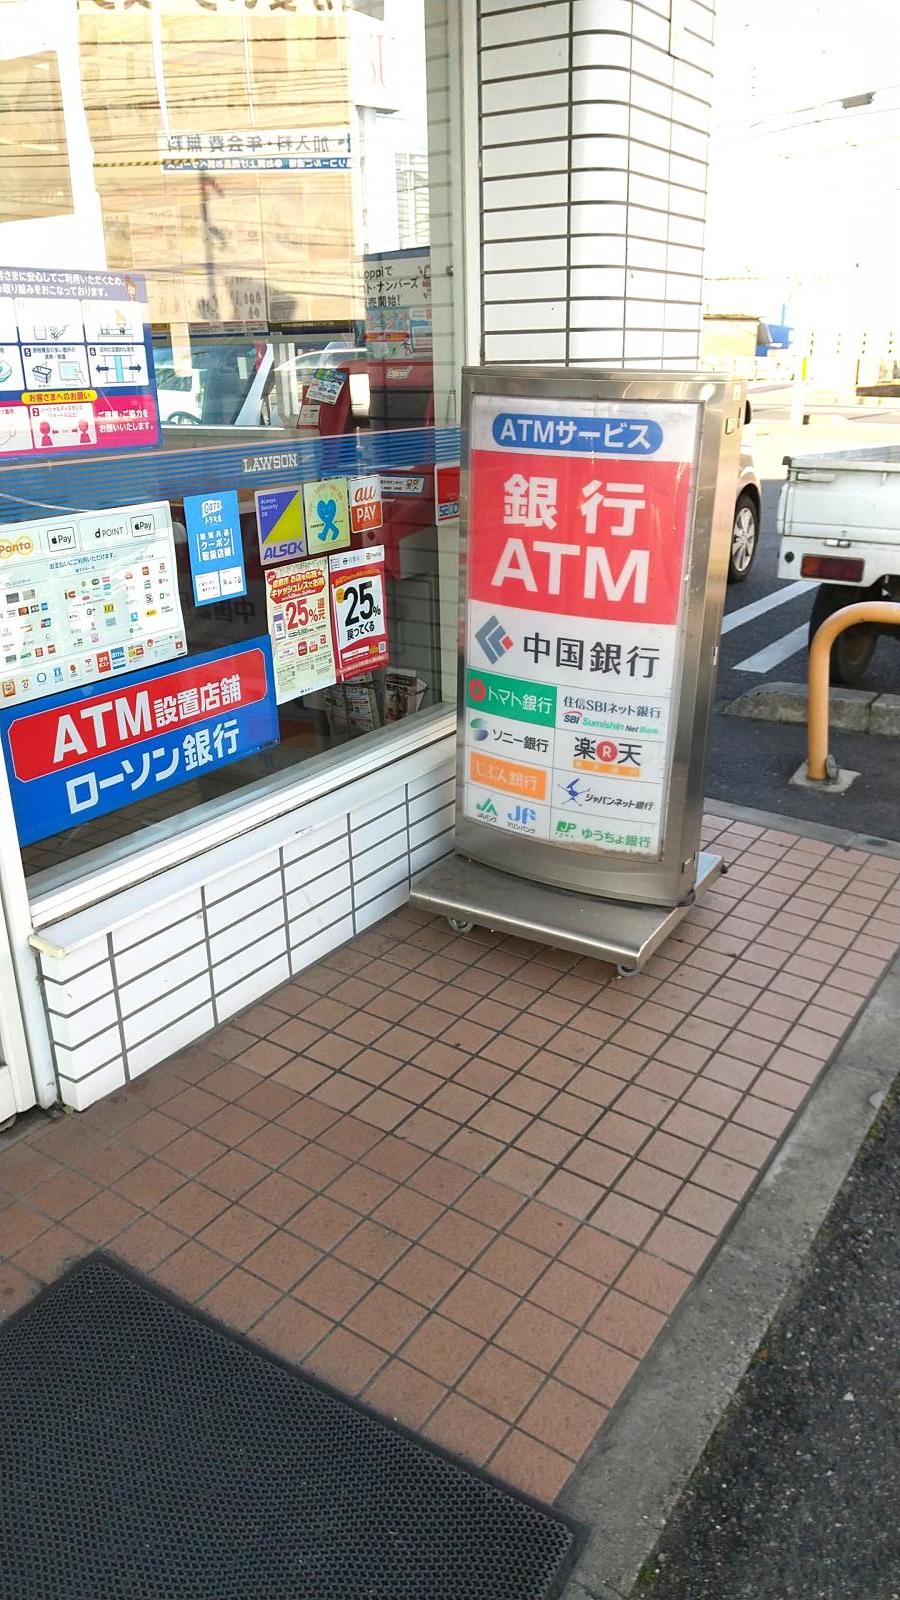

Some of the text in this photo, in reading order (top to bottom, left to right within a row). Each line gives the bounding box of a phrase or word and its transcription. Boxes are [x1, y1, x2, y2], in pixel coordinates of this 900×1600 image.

[365, 294, 401, 308] 売開始!
[29, 391, 91, 403] お客さまへのお願い
[499, 418, 652, 450] ATMサービス
[242, 453, 298, 473] LAWSON
[354, 486, 376, 502] au
[356, 505, 378, 522] PAY
[503, 474, 646, 537] 銀行
[102, 526, 124, 537] POINT
[139, 521, 152, 532] Pay
[0, 540, 31, 555] Ponta
[58, 534, 72, 545] Pay
[201, 537, 231, 551] クーポン
[263, 541, 304, 561] ALSOK
[490, 537, 651, 604] ATM
[344, 581, 381, 627] 25%
[346, 620, 376, 641] 戻ってくる
[523, 632, 660, 679] 中国銀行
[488, 686, 553, 715] トマト銀行
[563, 695, 661, 719] 住信SBIネット銀行
[52, 674, 242, 765] ATM設置店舗
[563, 711, 581, 725] SBI
[582, 717, 624, 732] Sumishin
[625, 724, 639, 733] Net
[492, 728, 549, 753] ソニー銀行
[65, 719, 240, 815] ローソン銀行
[584, 792, 655, 811] ジャパンネット銀行
[506, 822, 536, 834] マリンバンク
[581, 827, 652, 849] ゆうちょ銀行
